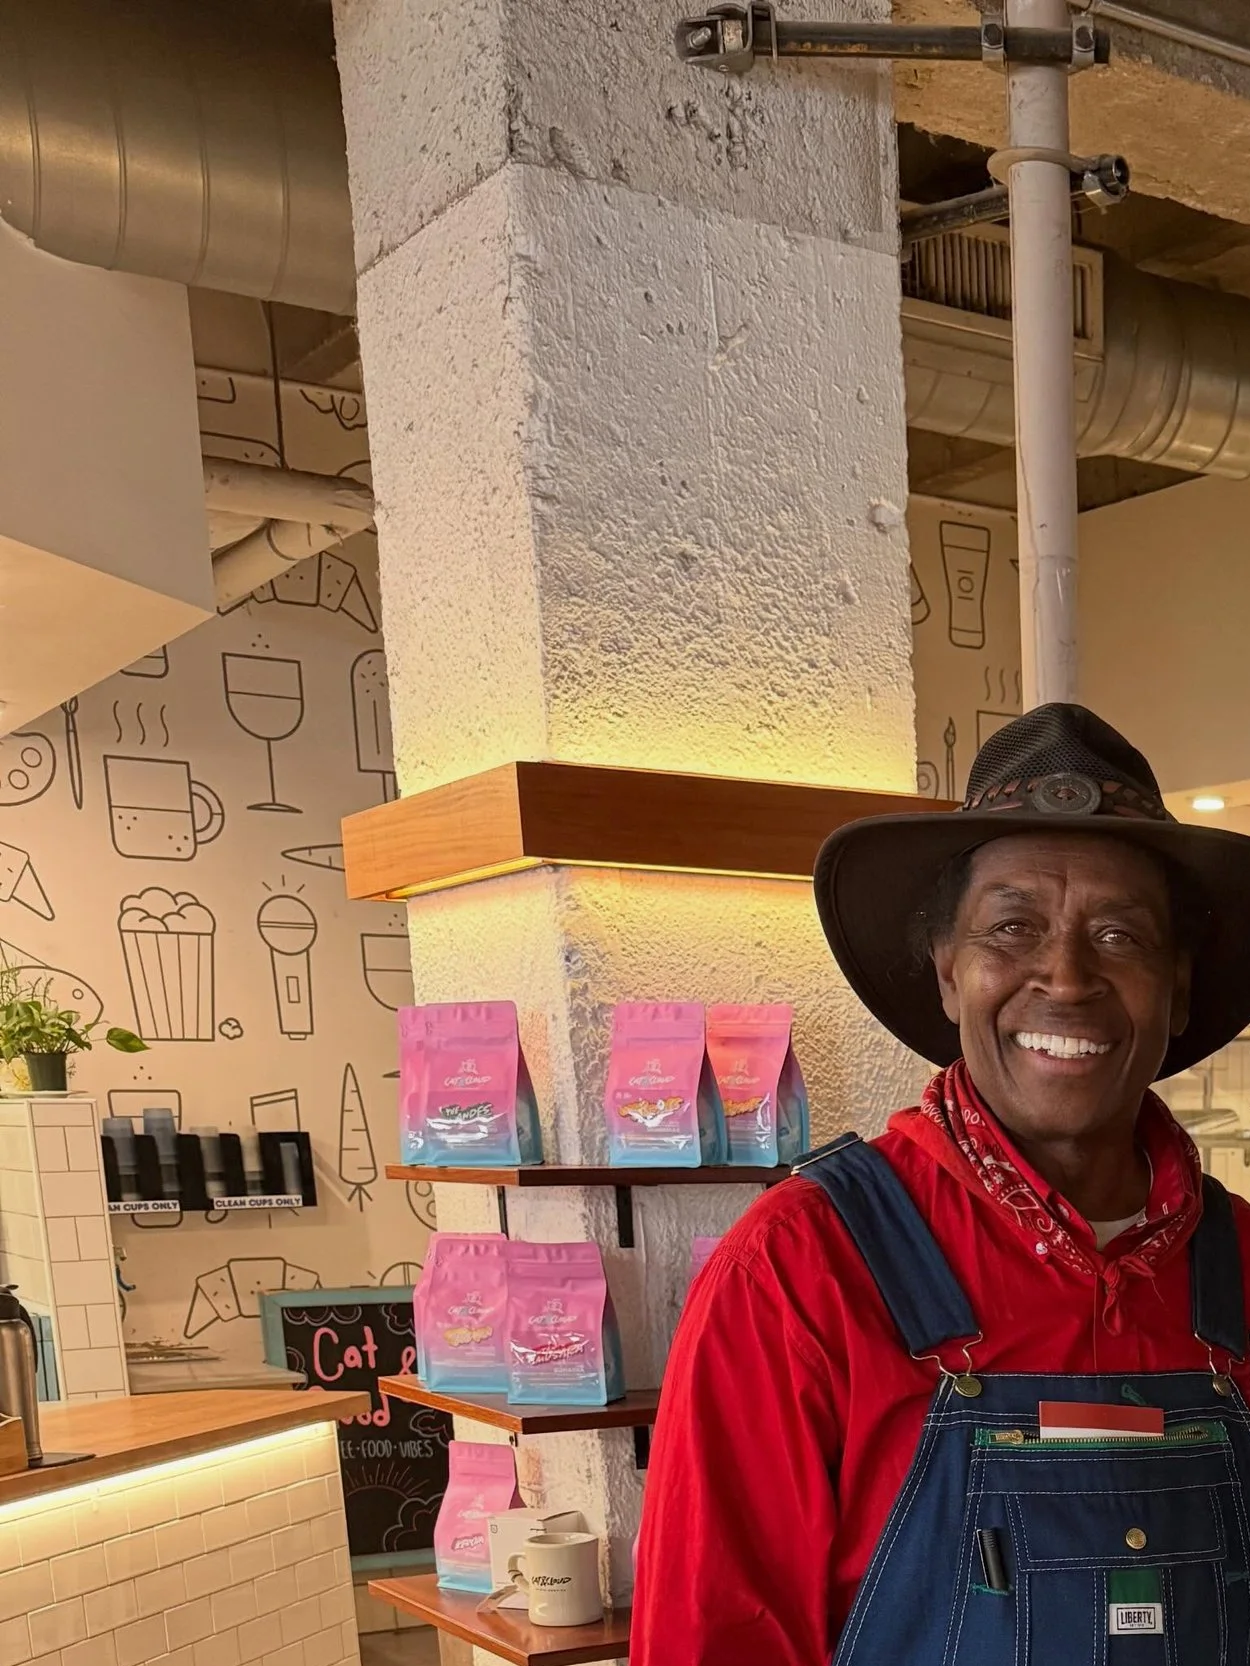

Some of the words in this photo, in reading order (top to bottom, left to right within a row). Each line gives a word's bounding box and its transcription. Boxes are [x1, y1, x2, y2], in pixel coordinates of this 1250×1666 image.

[123, 1202, 149, 1212] CUPS
[151, 1201, 178, 1211] ONLY
[215, 1199, 247, 1208] CLEAN
[248, 1198, 274, 1207] CUPS
[275, 1197, 301, 1206] ONLY
[313, 1325, 379, 1382] Cat
[361, 1440, 393, 1458] FOOD
[400, 1439, 434, 1458] VIBES
